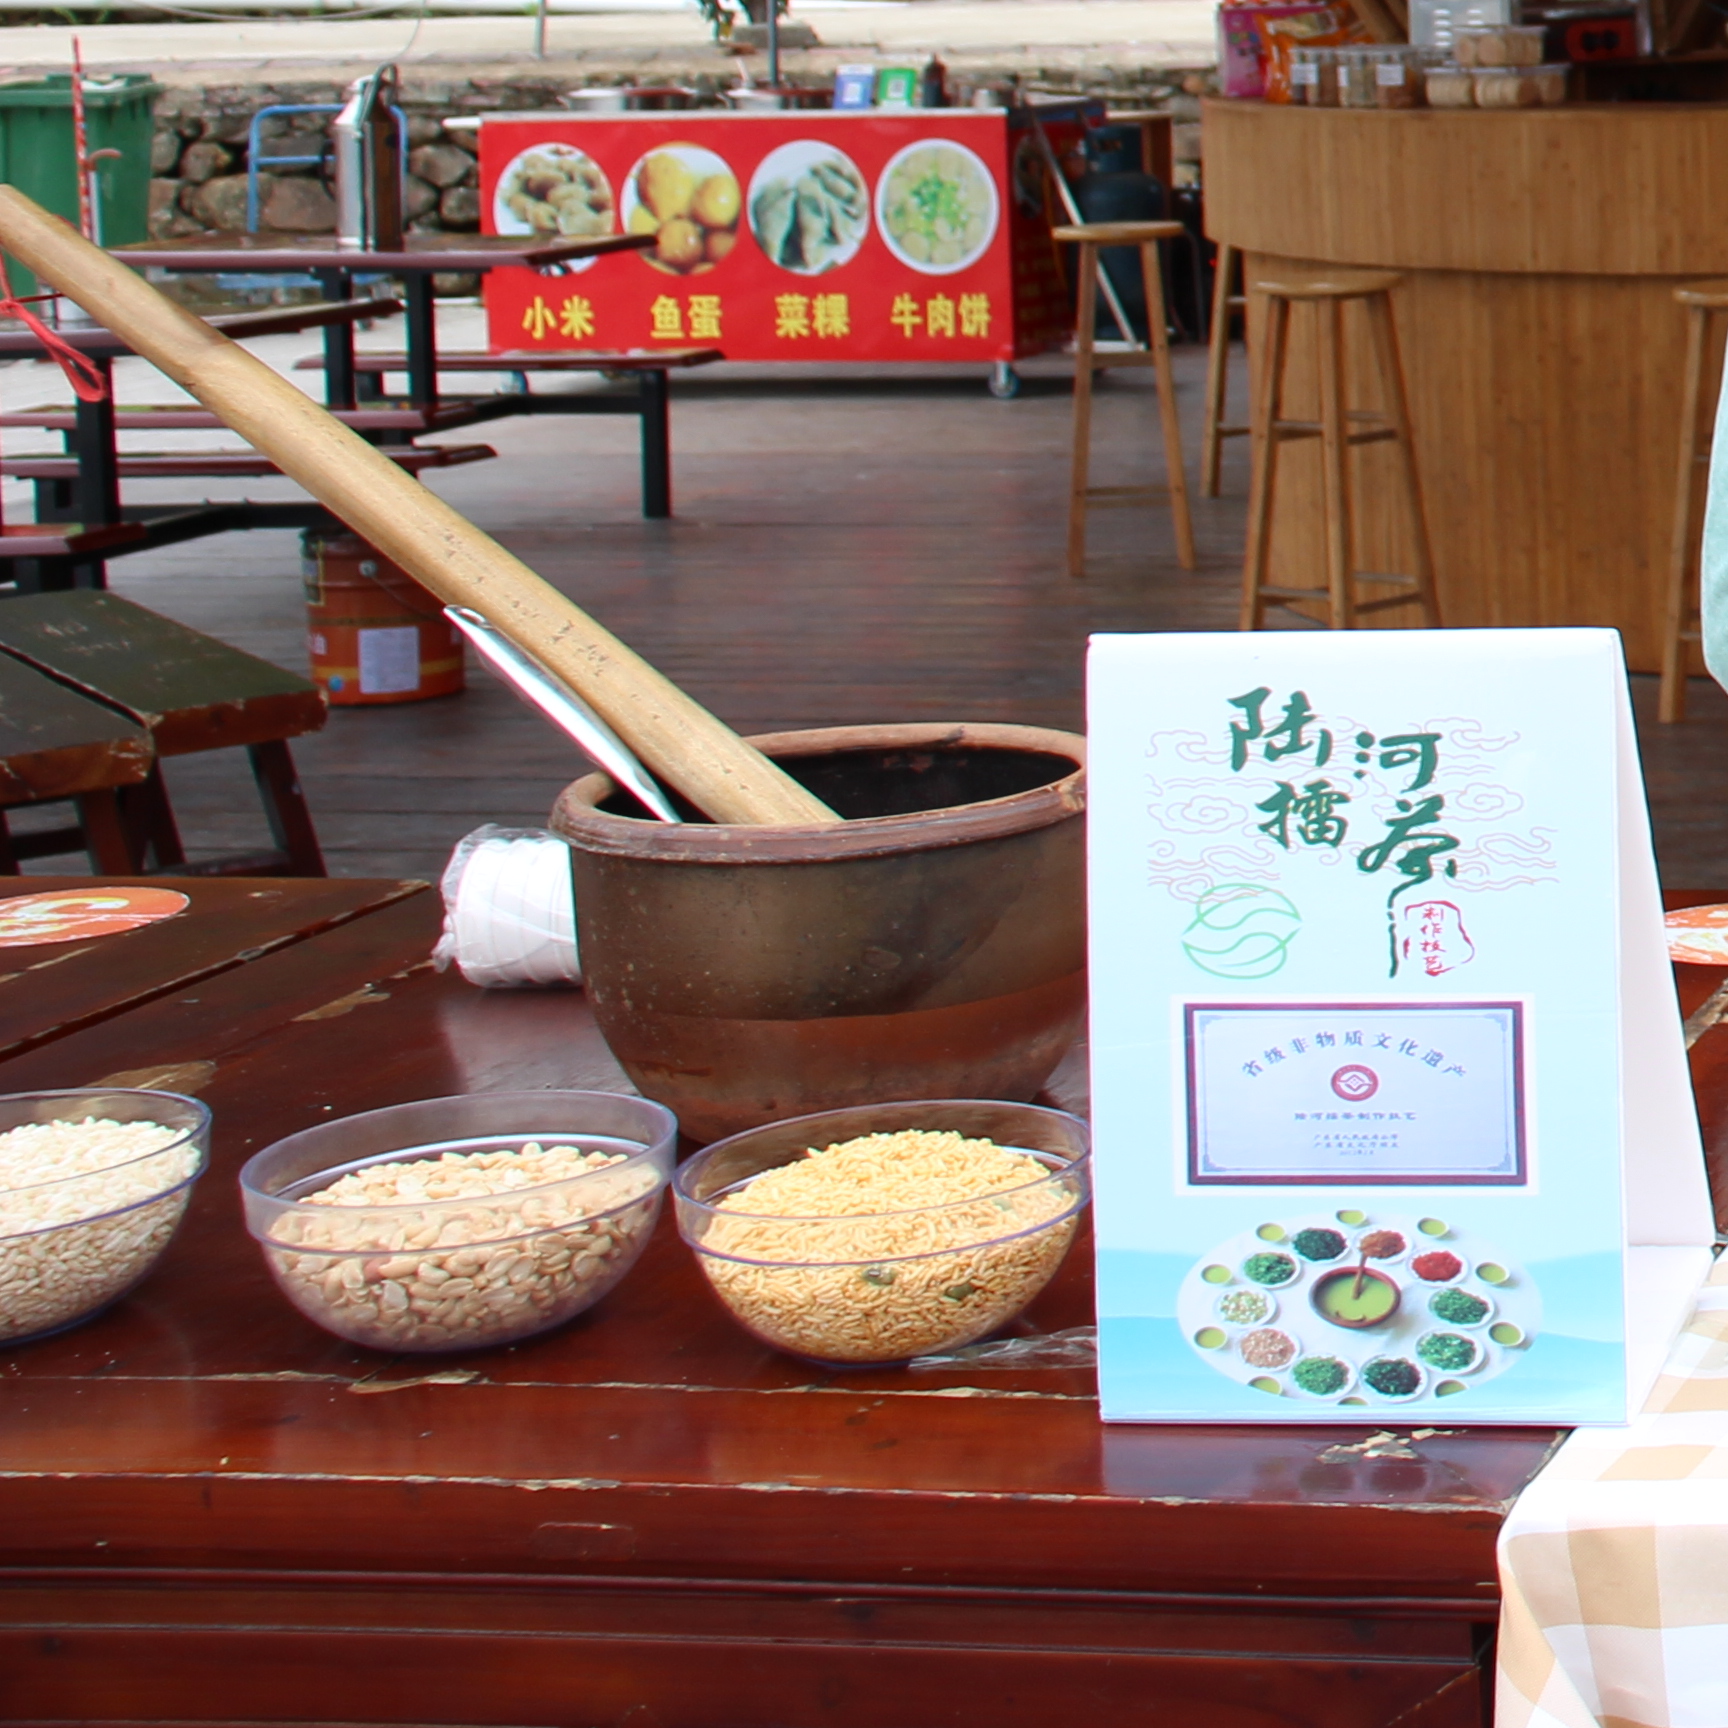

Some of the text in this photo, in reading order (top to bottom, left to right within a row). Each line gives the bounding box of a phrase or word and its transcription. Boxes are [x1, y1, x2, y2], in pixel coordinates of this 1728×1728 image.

[522, 295, 595, 341] 小米
[650, 295, 723, 339] 鱼蛋
[890, 292, 992, 338] 牛肉饼
[1241, 1029, 1467, 1078] 省级非物质文化遗产
